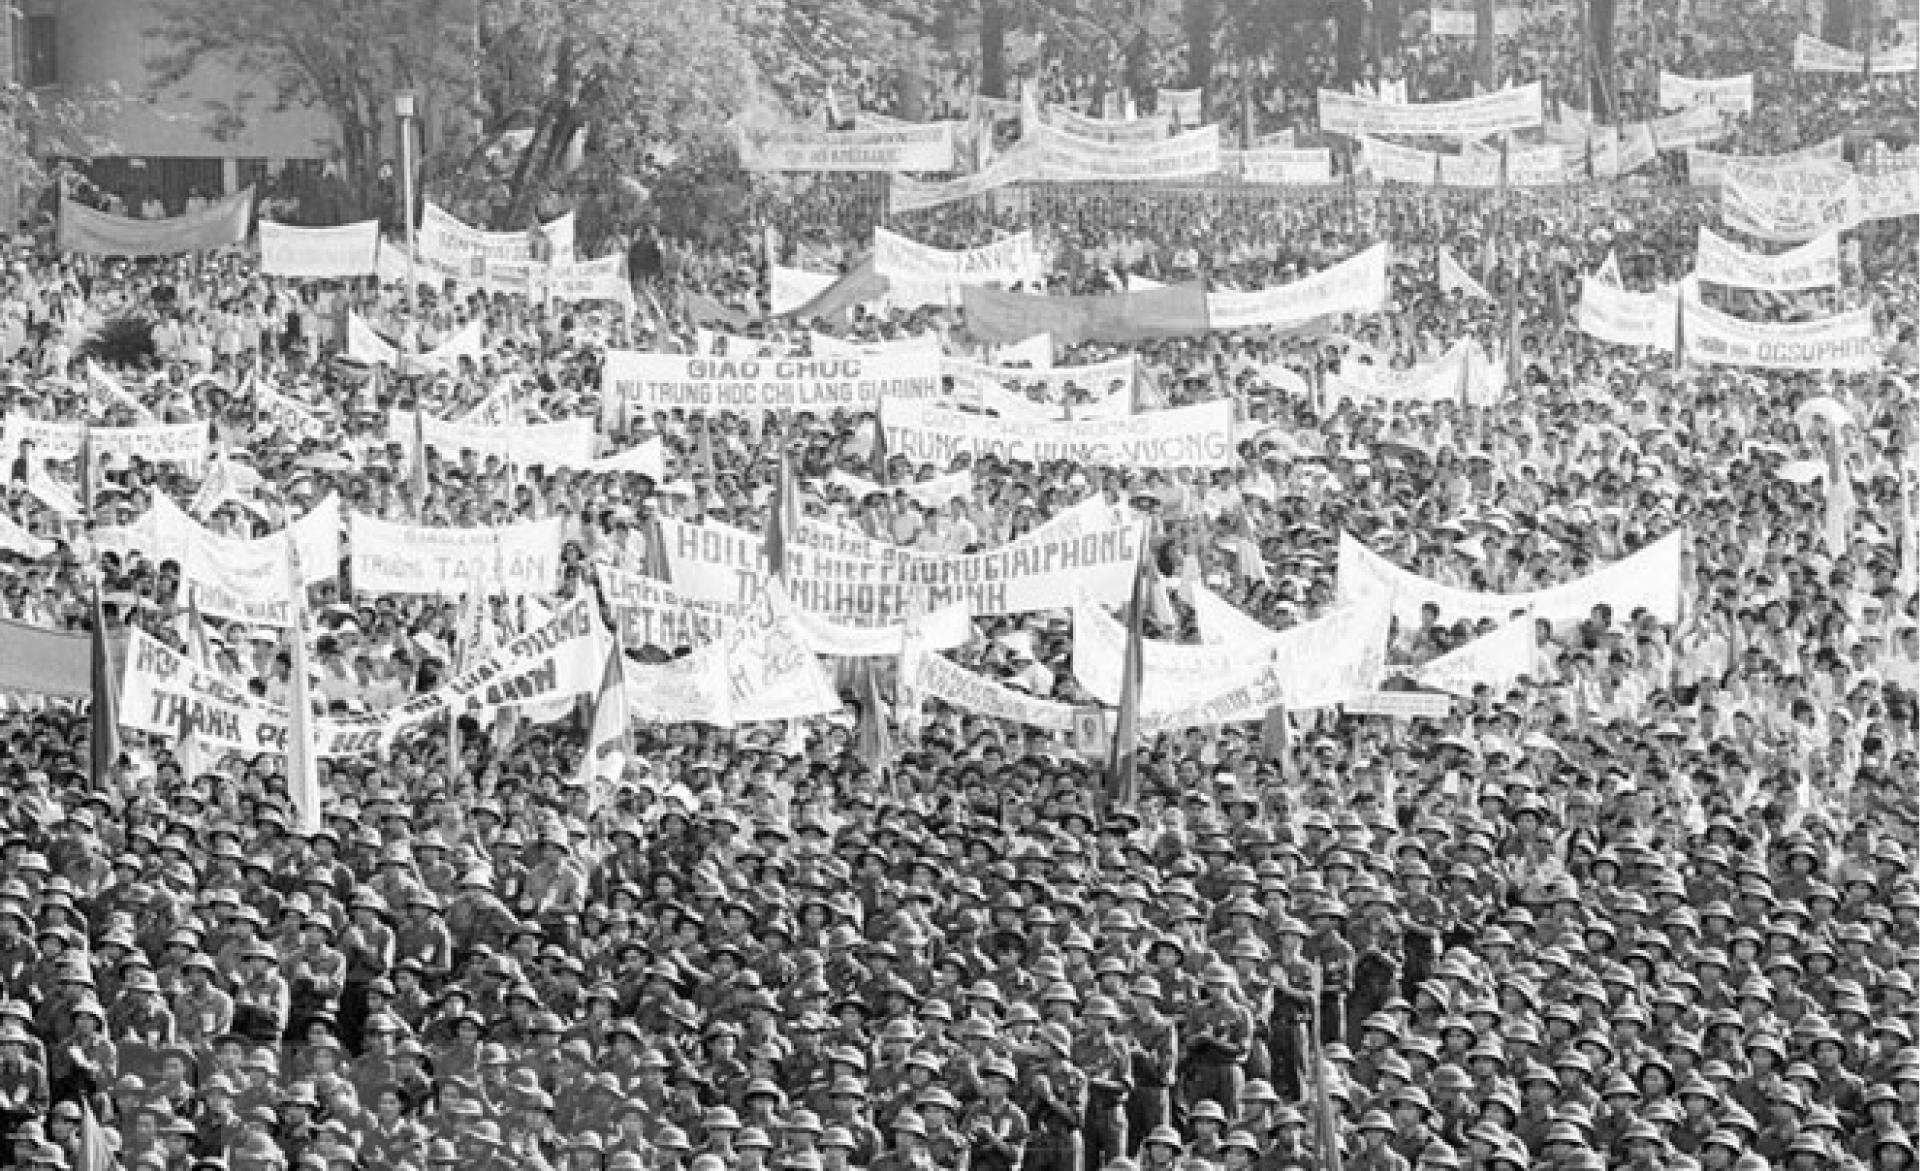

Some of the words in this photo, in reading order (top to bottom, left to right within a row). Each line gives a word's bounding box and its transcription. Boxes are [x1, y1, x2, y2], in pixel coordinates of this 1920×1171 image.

[686, 359, 760, 380] GIAO
[775, 359, 862, 380] CHUC
[647, 382, 713, 404] TRUNG
[717, 382, 757, 404] HOC
[761, 382, 795, 404] CHI
[799, 382, 853, 404] LANG
[1043, 526, 1134, 576] PHONG
